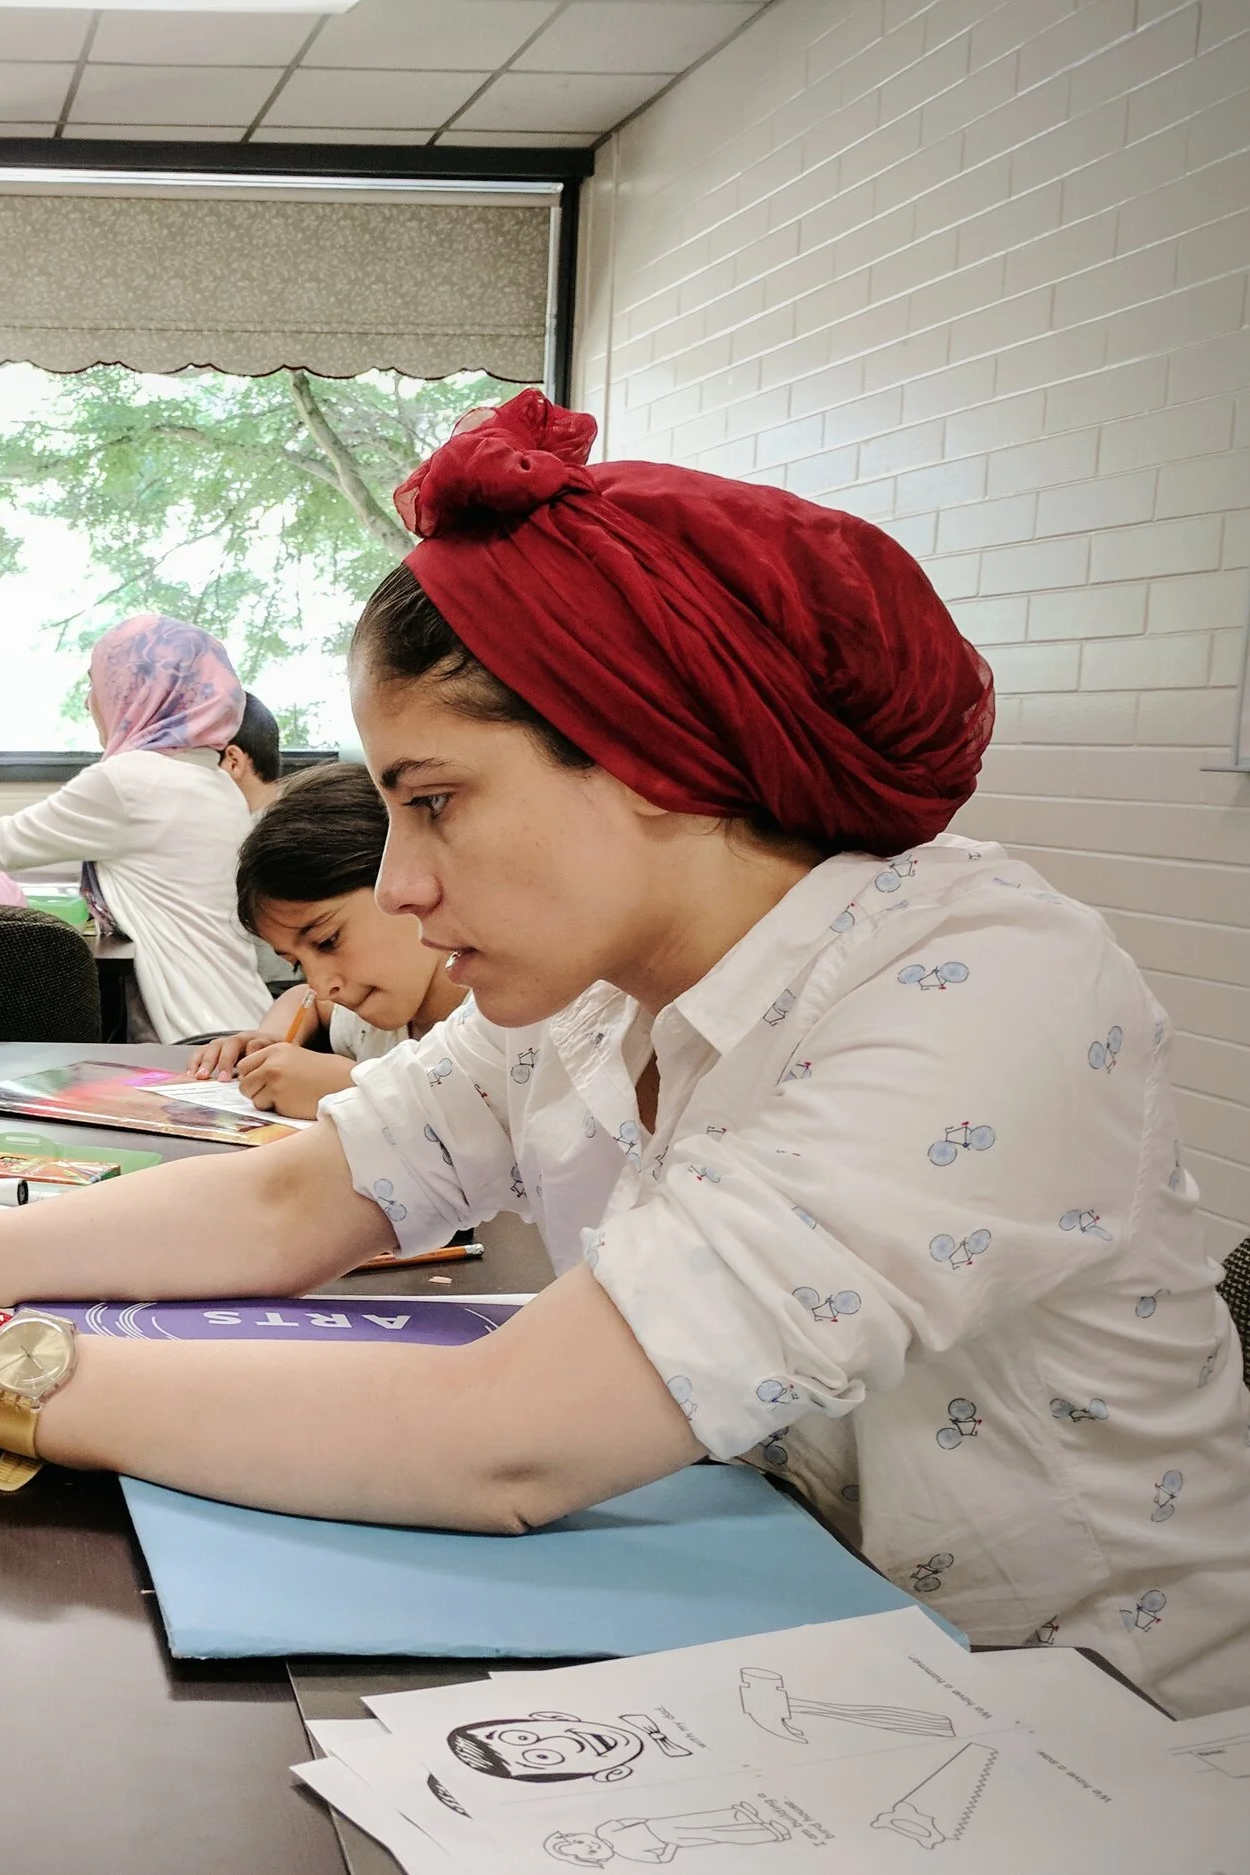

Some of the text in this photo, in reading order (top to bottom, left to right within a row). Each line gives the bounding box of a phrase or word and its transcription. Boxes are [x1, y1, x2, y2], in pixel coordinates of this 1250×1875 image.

[203, 1310, 412, 1331] ARTS
[952, 1688, 976, 1706] have
[975, 1706, 993, 1720] We
[1066, 1771, 1093, 1789] have
[1092, 1788, 1112, 1804] We
